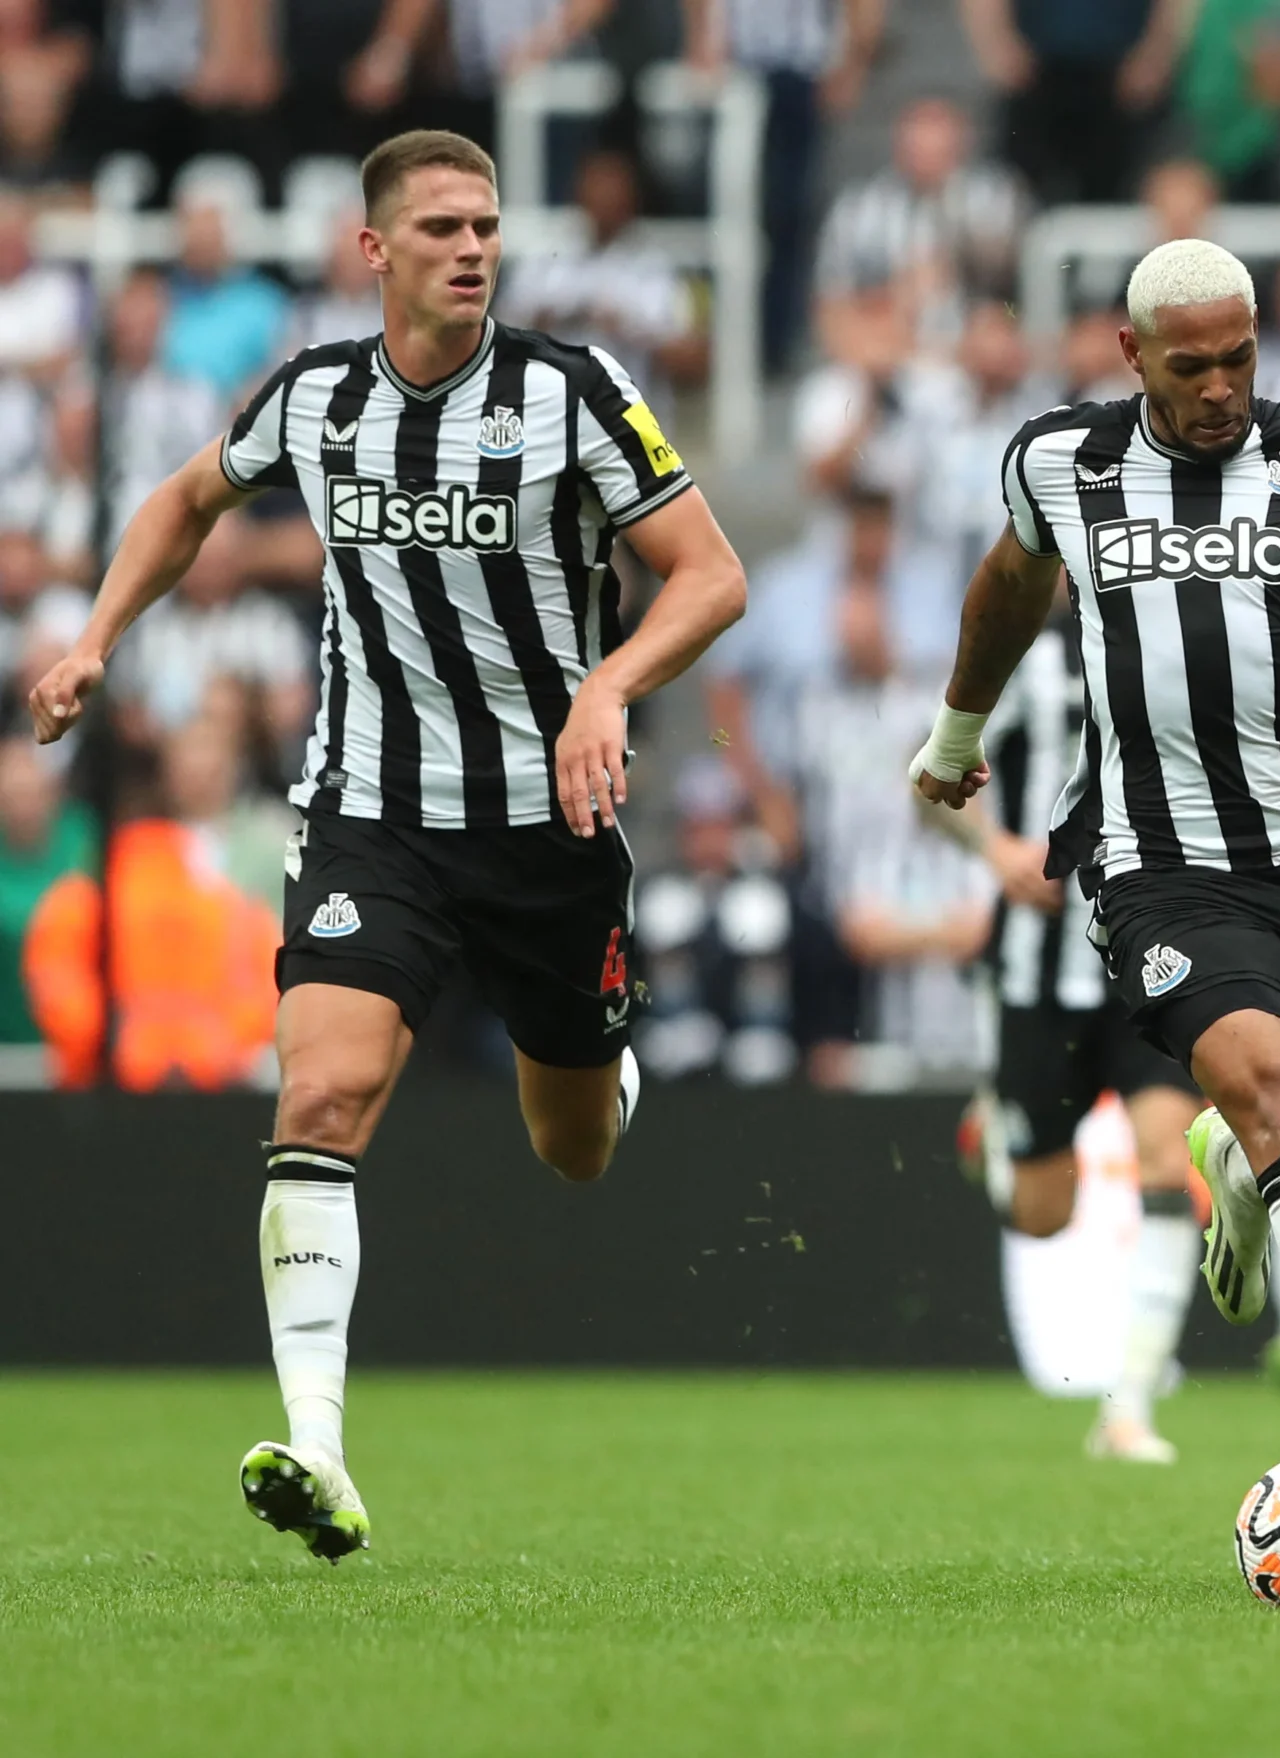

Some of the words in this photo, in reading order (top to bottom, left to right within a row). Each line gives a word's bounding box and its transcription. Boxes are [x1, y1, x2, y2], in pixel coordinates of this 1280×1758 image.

[383, 490, 507, 545] sela
[600, 925, 627, 997] 4
[273, 1252, 342, 1268] NUFC
